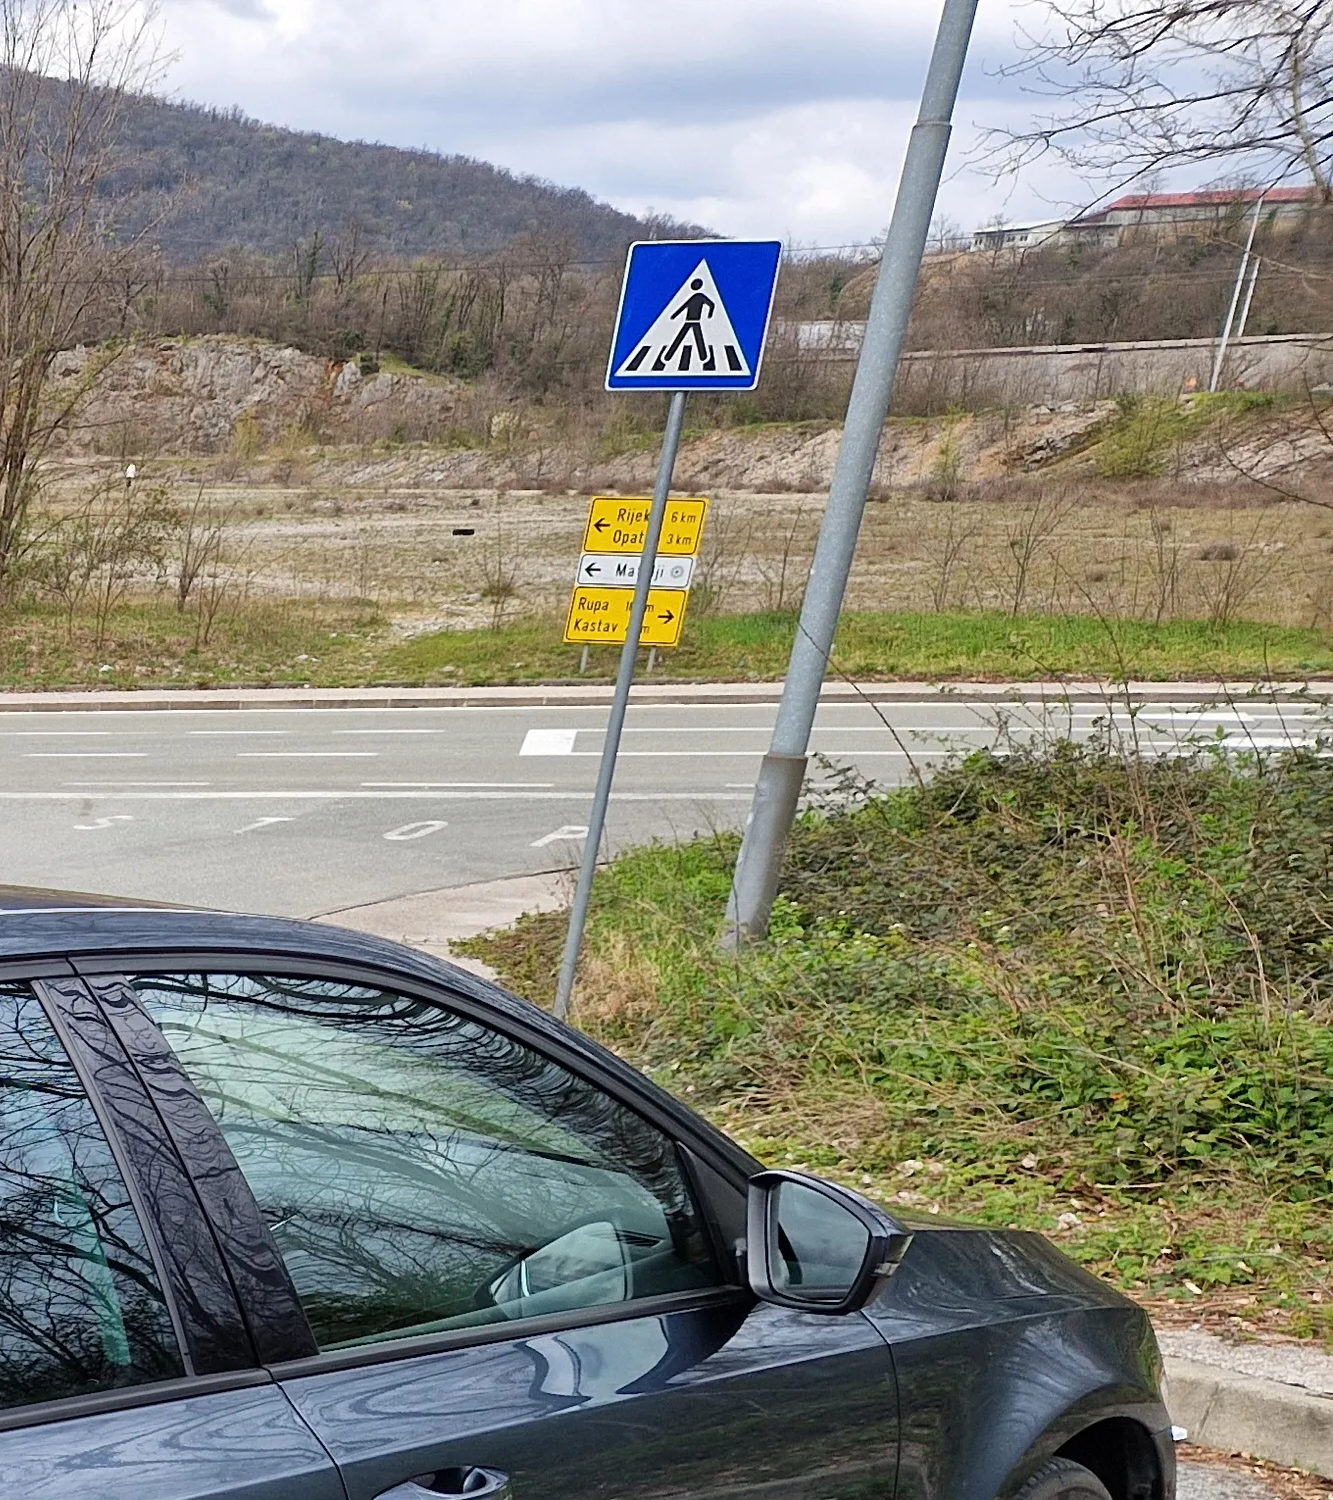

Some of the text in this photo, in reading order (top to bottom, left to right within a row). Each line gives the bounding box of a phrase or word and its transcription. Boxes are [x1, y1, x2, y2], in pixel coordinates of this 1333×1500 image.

[617, 508, 696, 526] Rijek 6 km
[613, 529, 692, 547] Opat 3 km
[615, 563, 664, 582] Maji
[578, 597, 609, 613] Rupa
[574, 618, 618, 633] Kastav
[74, 815, 590, 847] STOP
